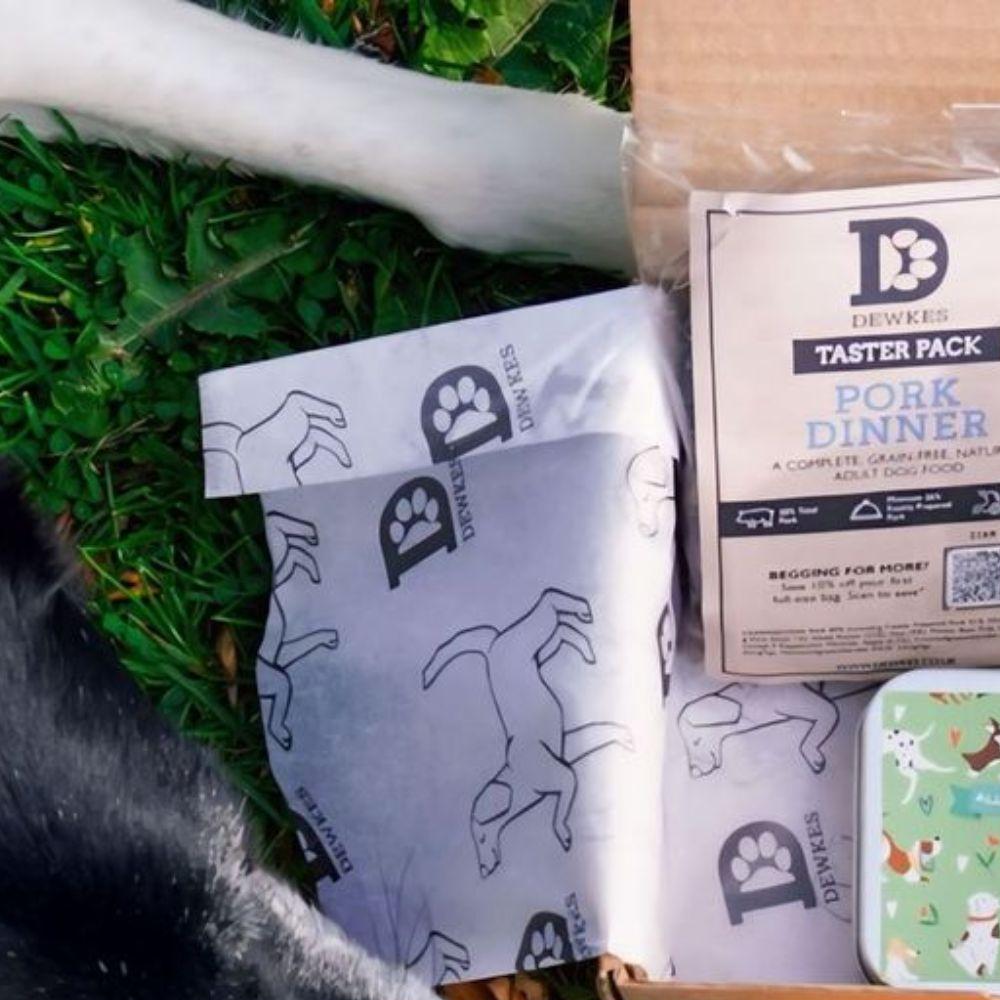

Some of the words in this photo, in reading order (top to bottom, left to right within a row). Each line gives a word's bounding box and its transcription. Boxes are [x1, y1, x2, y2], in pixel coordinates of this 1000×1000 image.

[852, 309, 949, 329] DEWKES
[816, 340, 909, 366] TASTER
[917, 335, 983, 361] PACK
[500, 343, 536, 434] DEWKES
[835, 377, 961, 414] PORK
[806, 409, 988, 450] DINNER
[772, 461, 781, 471] A
[884, 466, 917, 478] DOG
[921, 463, 965, 476] FOOD
[768, 567, 840, 580] BEGGING
[844, 564, 875, 575] FOR
[803, 811, 840, 904] DEWKES
